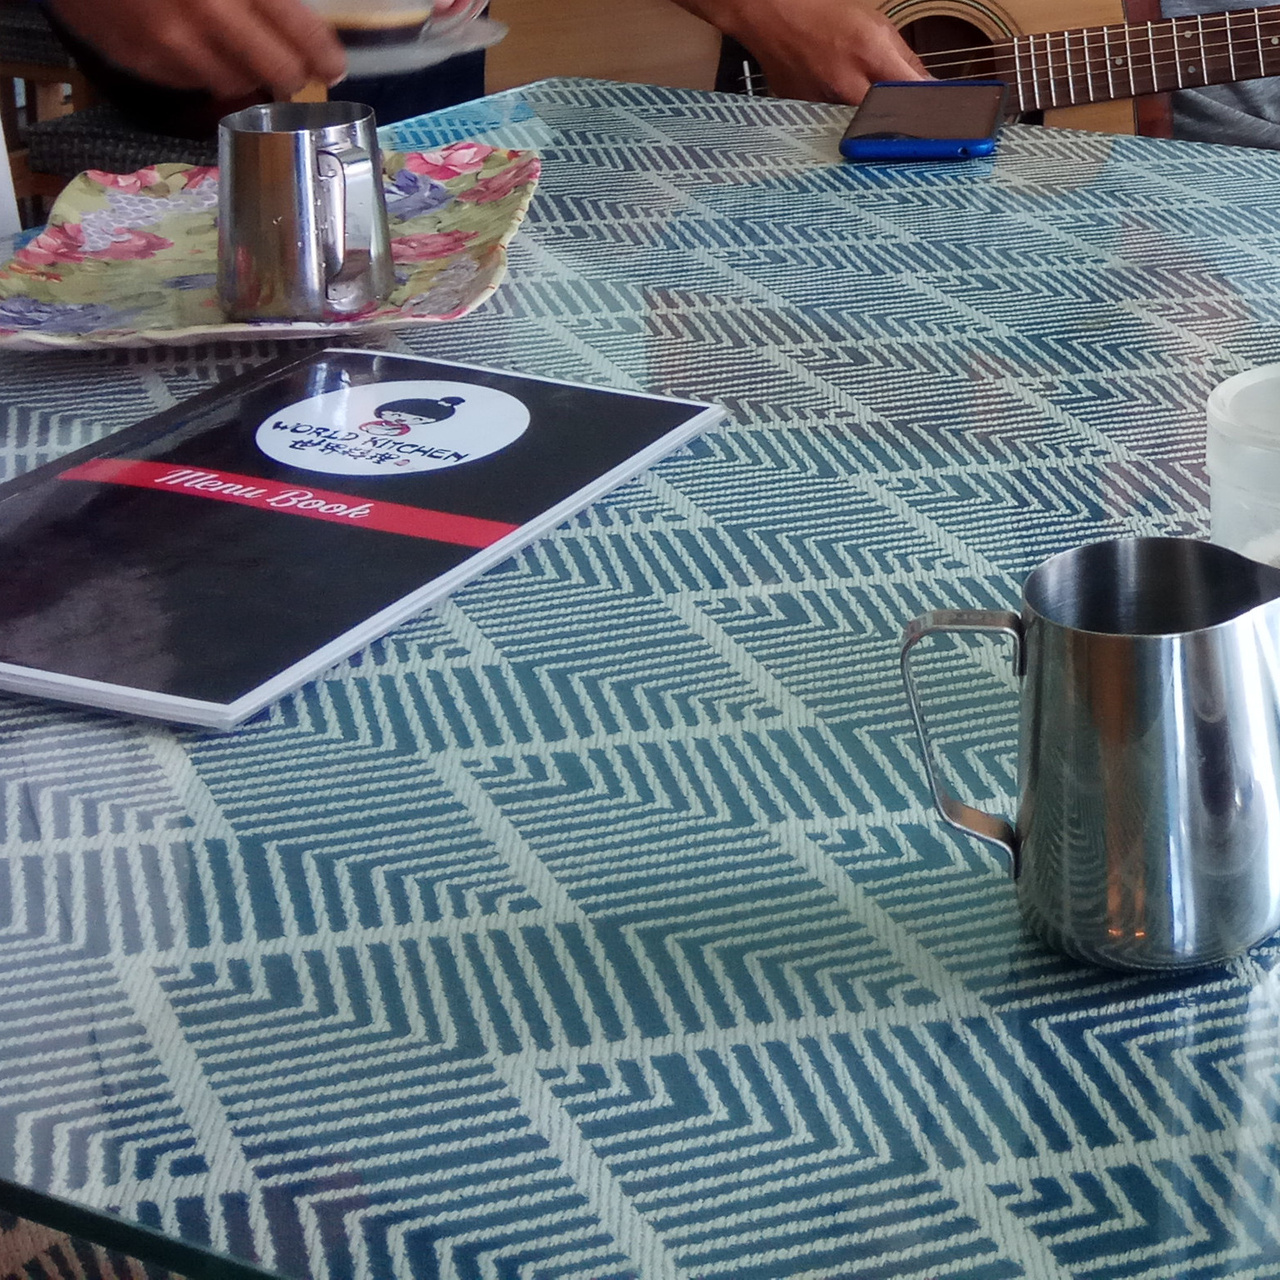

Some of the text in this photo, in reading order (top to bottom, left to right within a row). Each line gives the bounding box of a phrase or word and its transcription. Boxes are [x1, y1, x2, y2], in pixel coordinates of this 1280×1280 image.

[272, 421, 470, 463] WORLD KITCHEN
[154, 469, 375, 519] Menu Book
